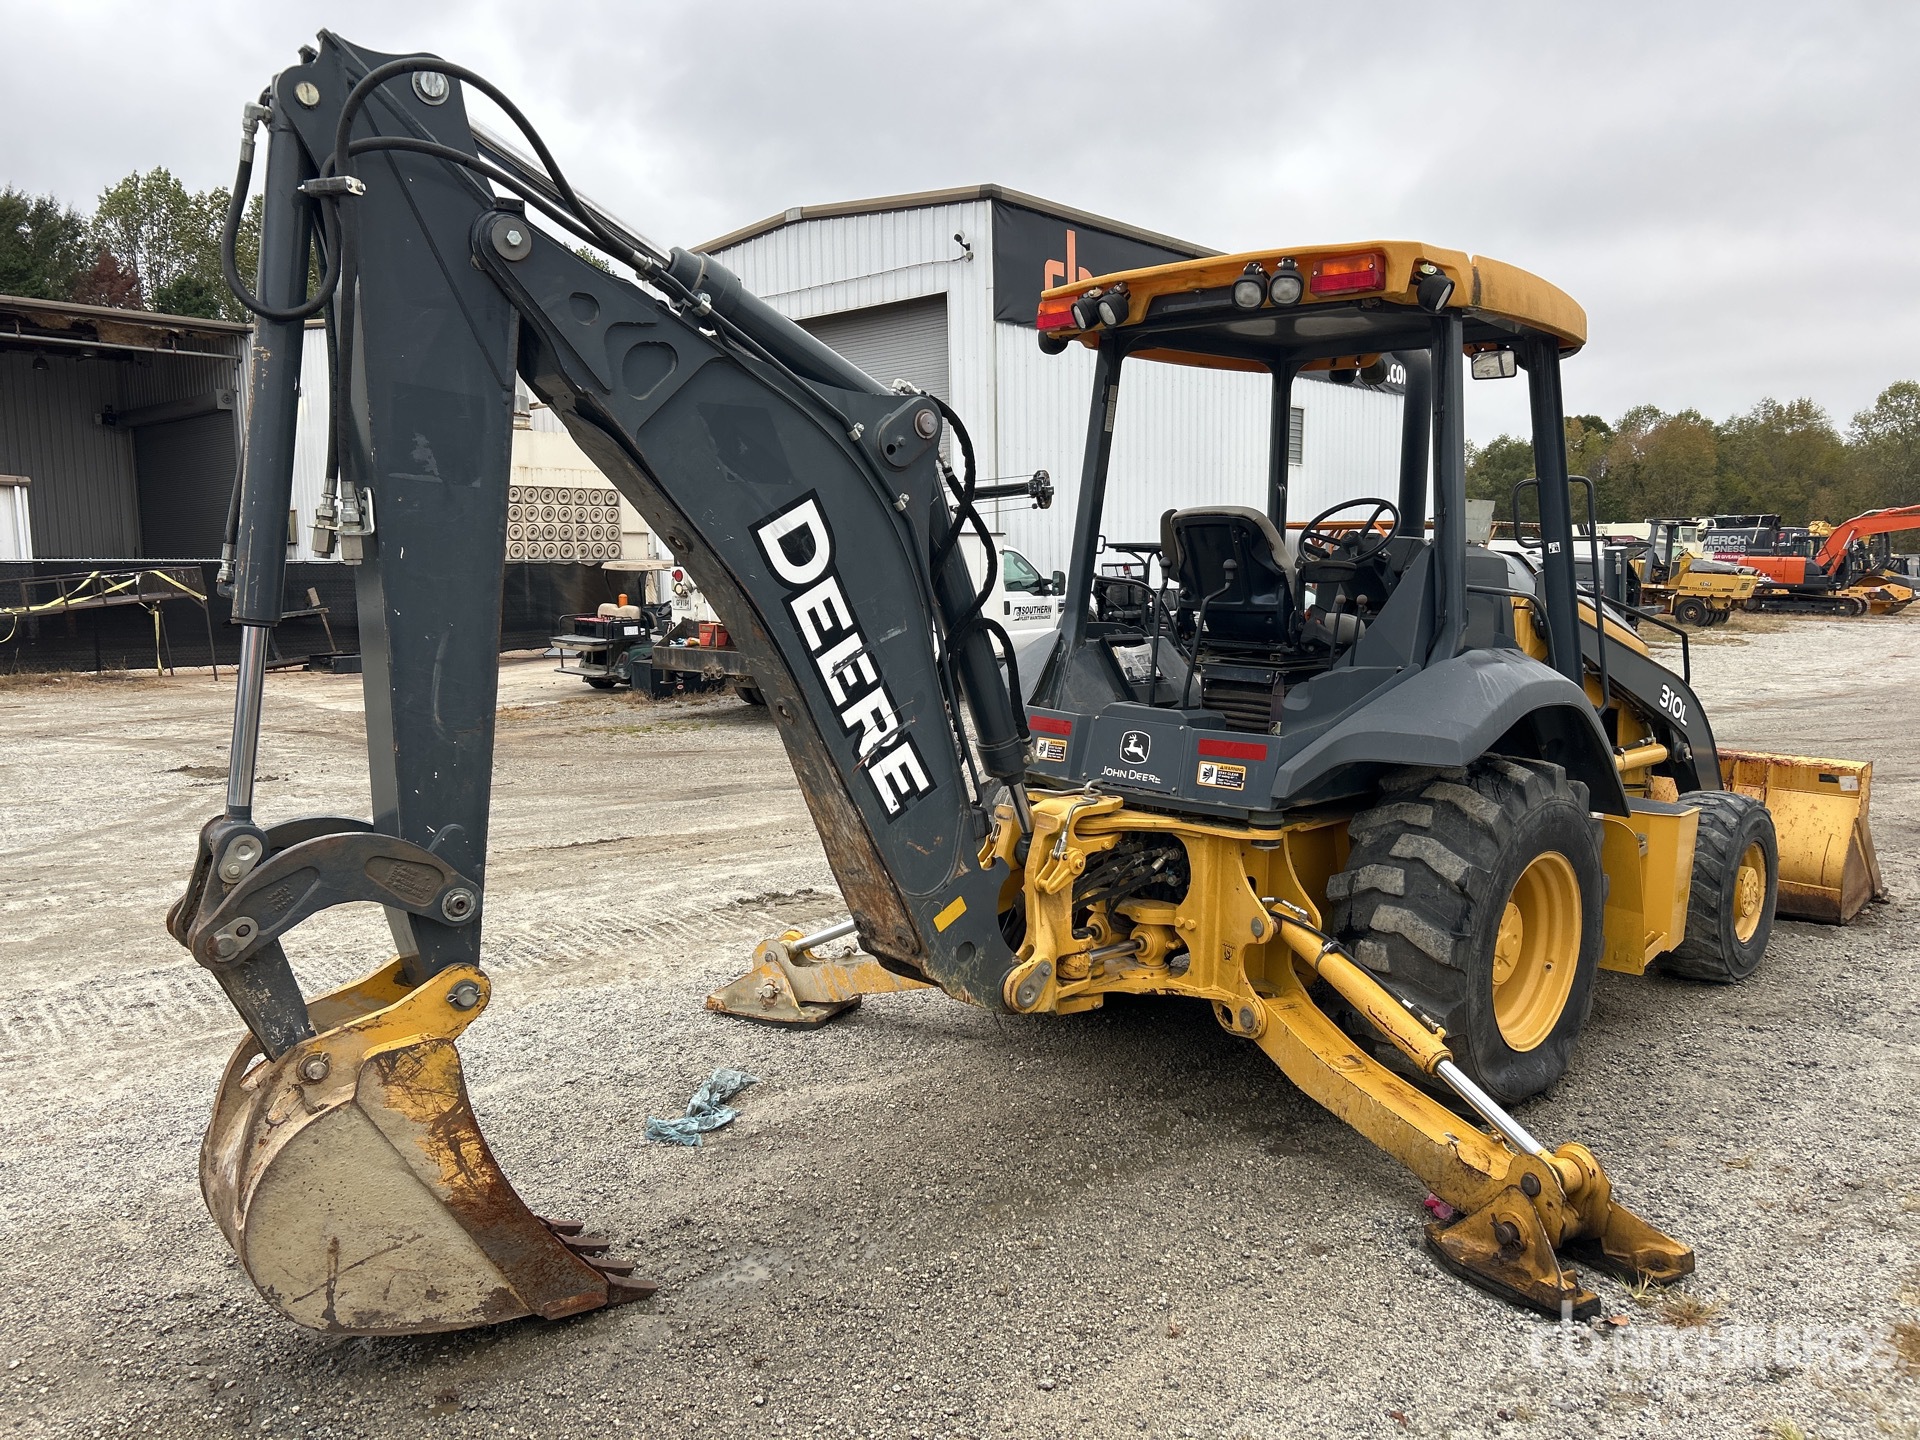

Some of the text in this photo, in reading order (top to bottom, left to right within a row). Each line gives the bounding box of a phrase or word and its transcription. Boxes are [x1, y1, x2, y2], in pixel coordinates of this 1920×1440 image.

[1703, 535, 1747, 545] MERCH
[1703, 545, 1746, 553] MADNESS
[1021, 605, 1053, 615] SOUTHERN
[756, 497, 931, 816] DEERE
[1658, 683, 1689, 727] 310L
[1223, 765, 1244, 773] WARNING
[1101, 765, 1161, 784] JOHN DEERE
